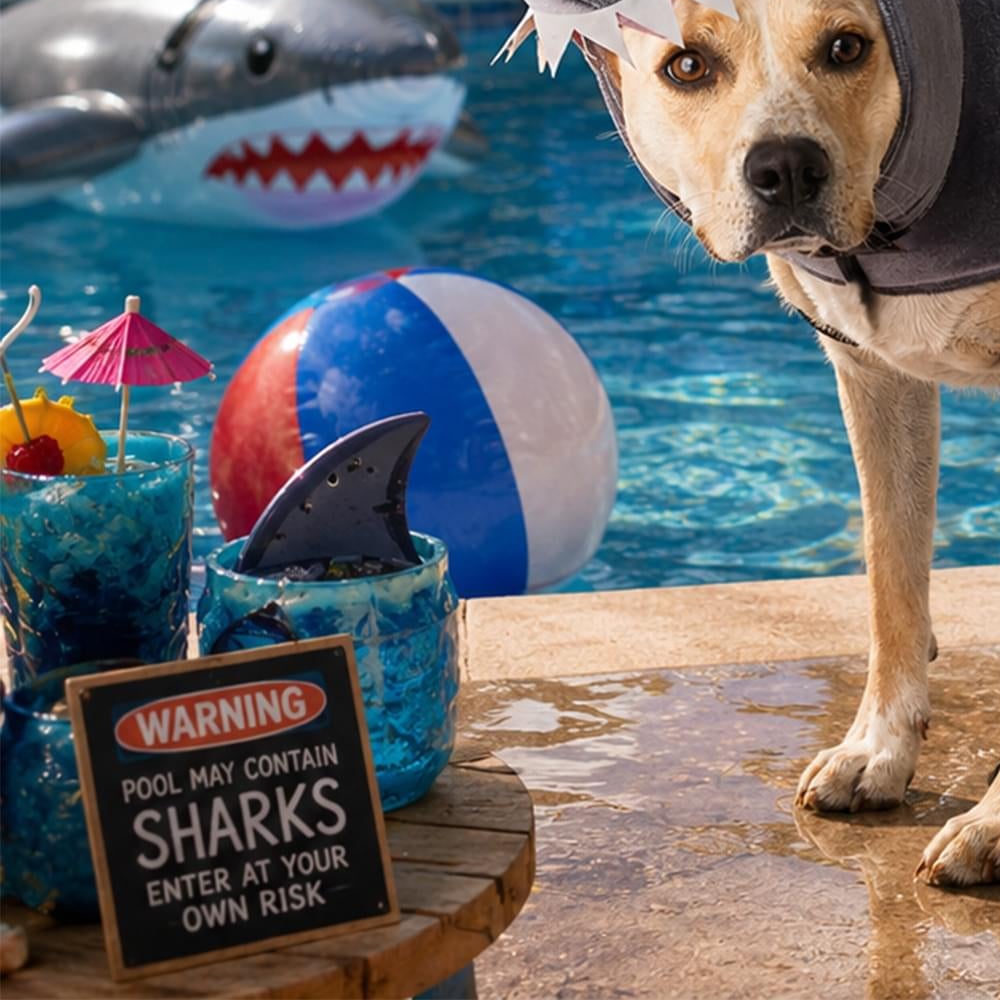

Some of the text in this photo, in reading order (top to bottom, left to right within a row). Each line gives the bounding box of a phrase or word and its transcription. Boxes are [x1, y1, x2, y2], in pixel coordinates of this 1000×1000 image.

[136, 686, 307, 747] WARNING
[121, 743, 339, 803] POOL MAY CONTAIN
[132, 777, 347, 869] SHARKS
[146, 845, 349, 906] ENTER AT YOUR
[182, 880, 326, 933] OWN RISK
